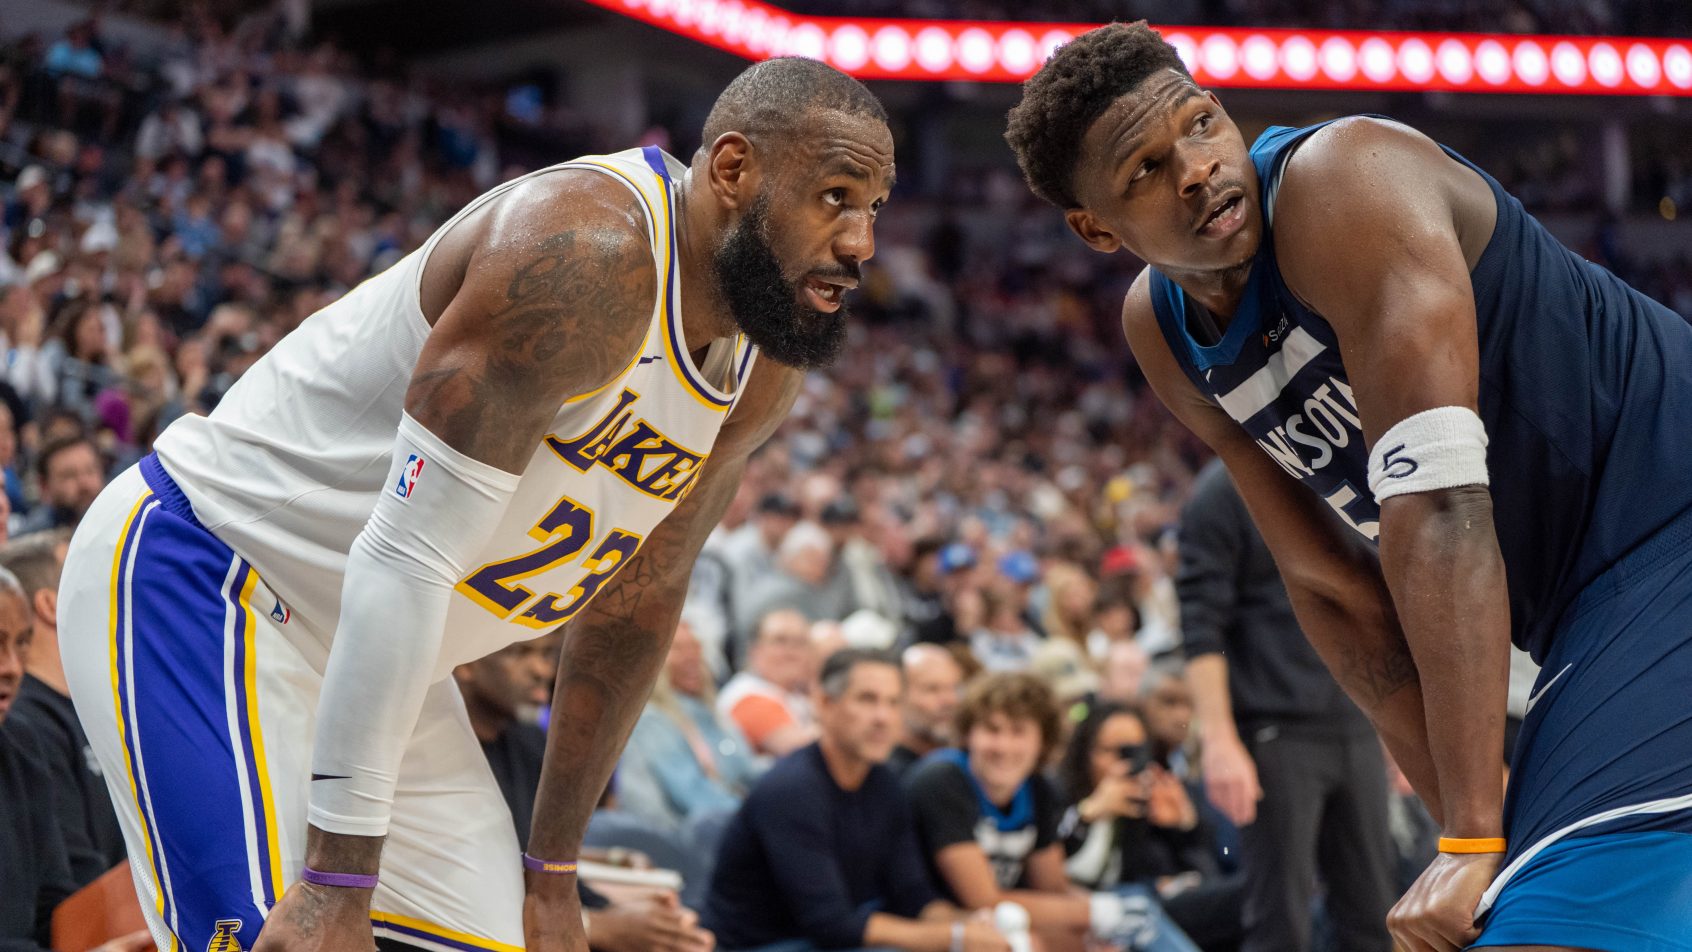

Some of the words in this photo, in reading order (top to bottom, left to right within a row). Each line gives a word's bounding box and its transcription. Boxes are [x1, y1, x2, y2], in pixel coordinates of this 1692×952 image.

[543, 386, 709, 502] LAKE
[1383, 443, 1418, 479] 5
[453, 494, 643, 630] 23
